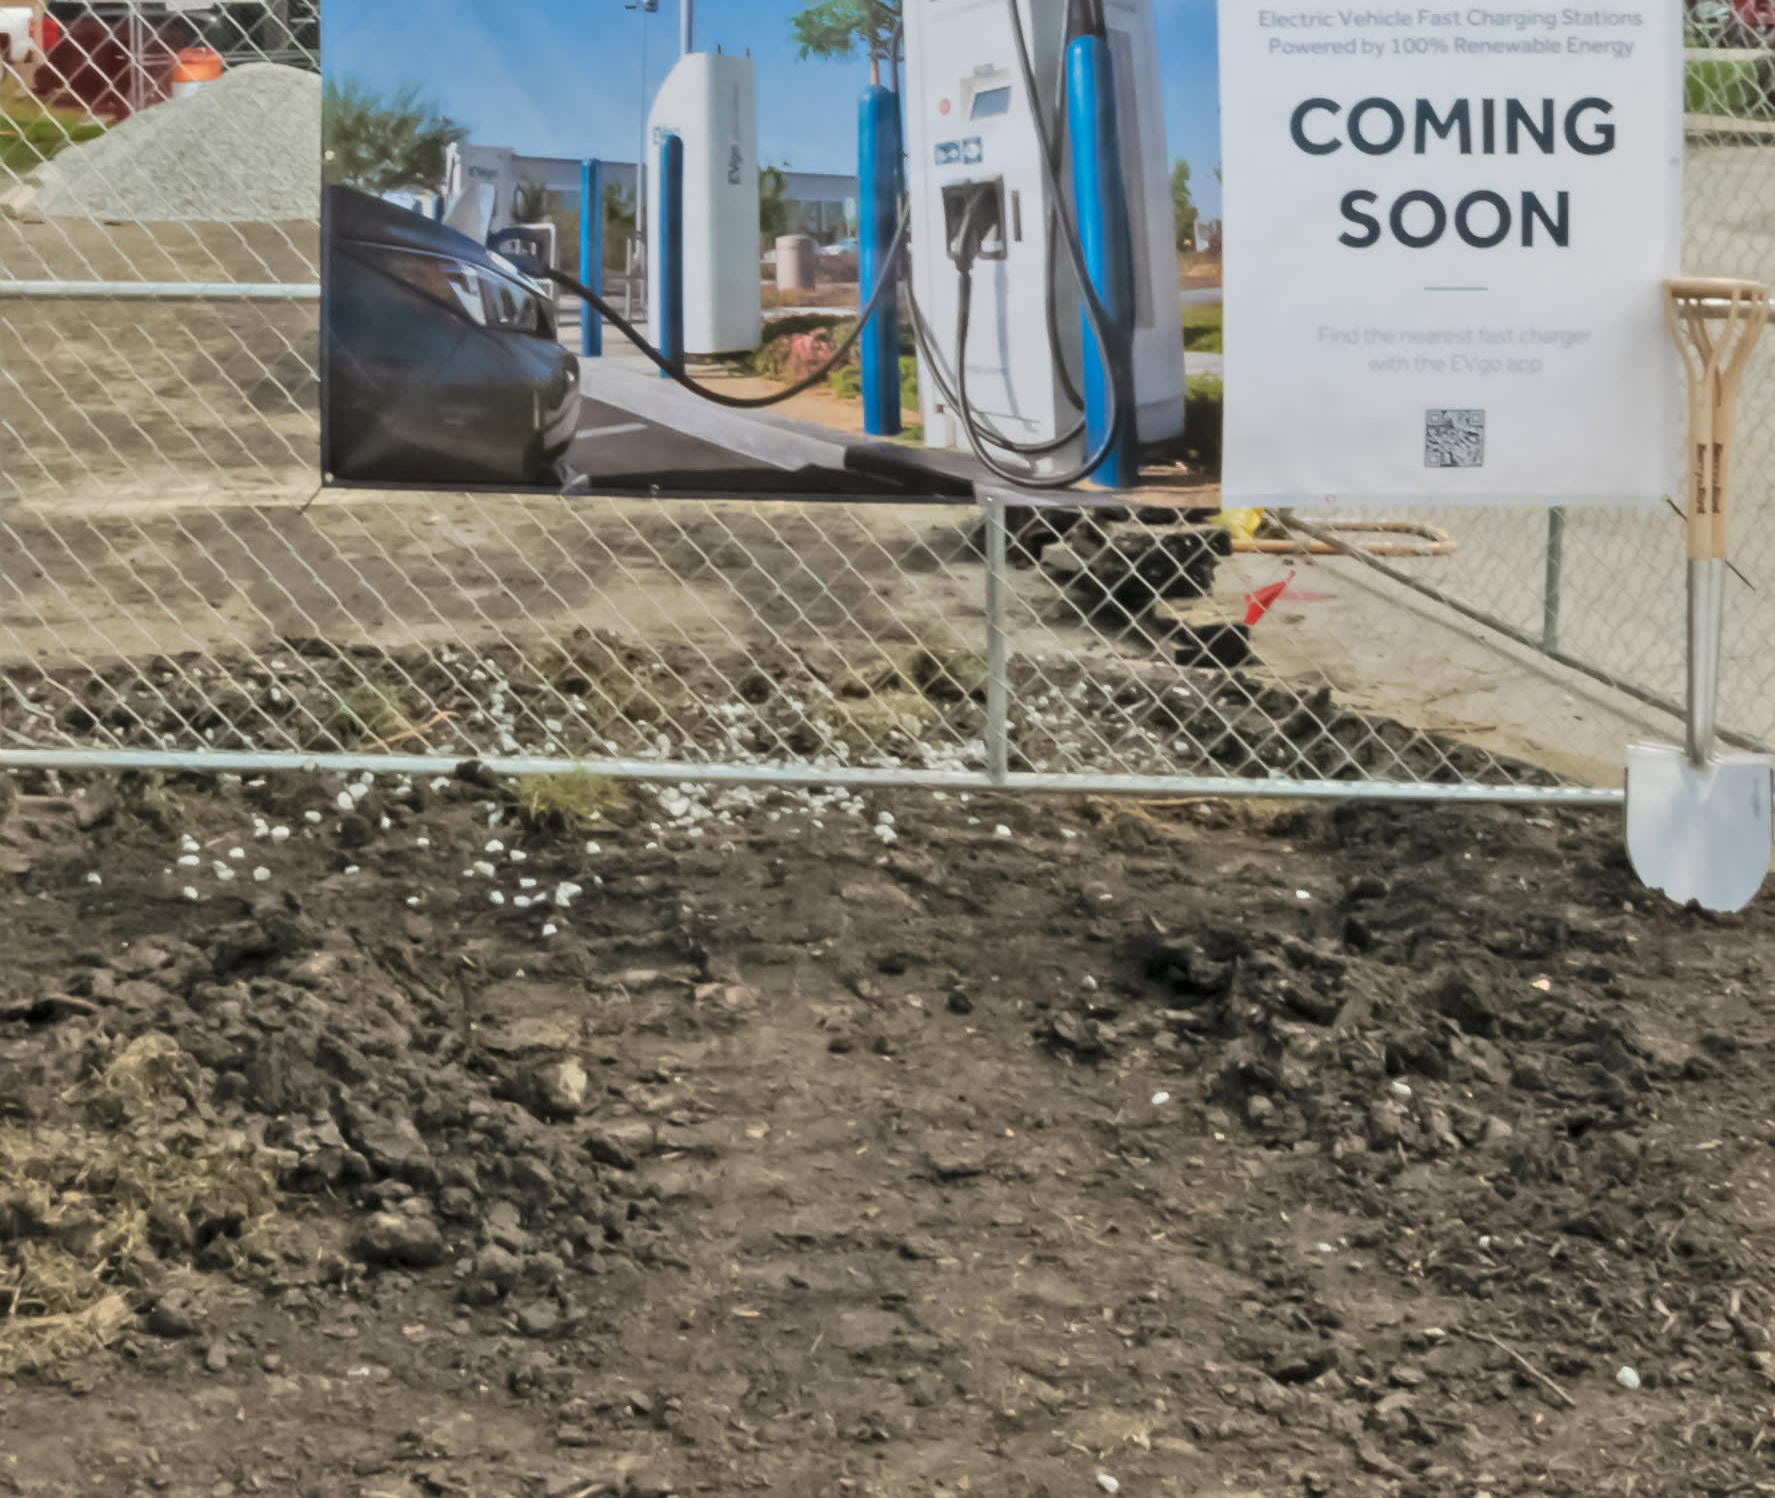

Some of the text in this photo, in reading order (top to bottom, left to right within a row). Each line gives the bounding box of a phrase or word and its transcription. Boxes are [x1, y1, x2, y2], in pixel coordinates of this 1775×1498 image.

[1258, 8, 1643, 30] Electric Vehicle Fast Charging Stations
[1268, 36, 1635, 58] Powered by 100% Renewable Energy
[1290, 97, 1616, 156] COMING
[1338, 190, 1570, 248] SOON
[1317, 326, 1592, 349] Find the nearest fast charger
[1368, 354, 1543, 376] with the EVgo app
